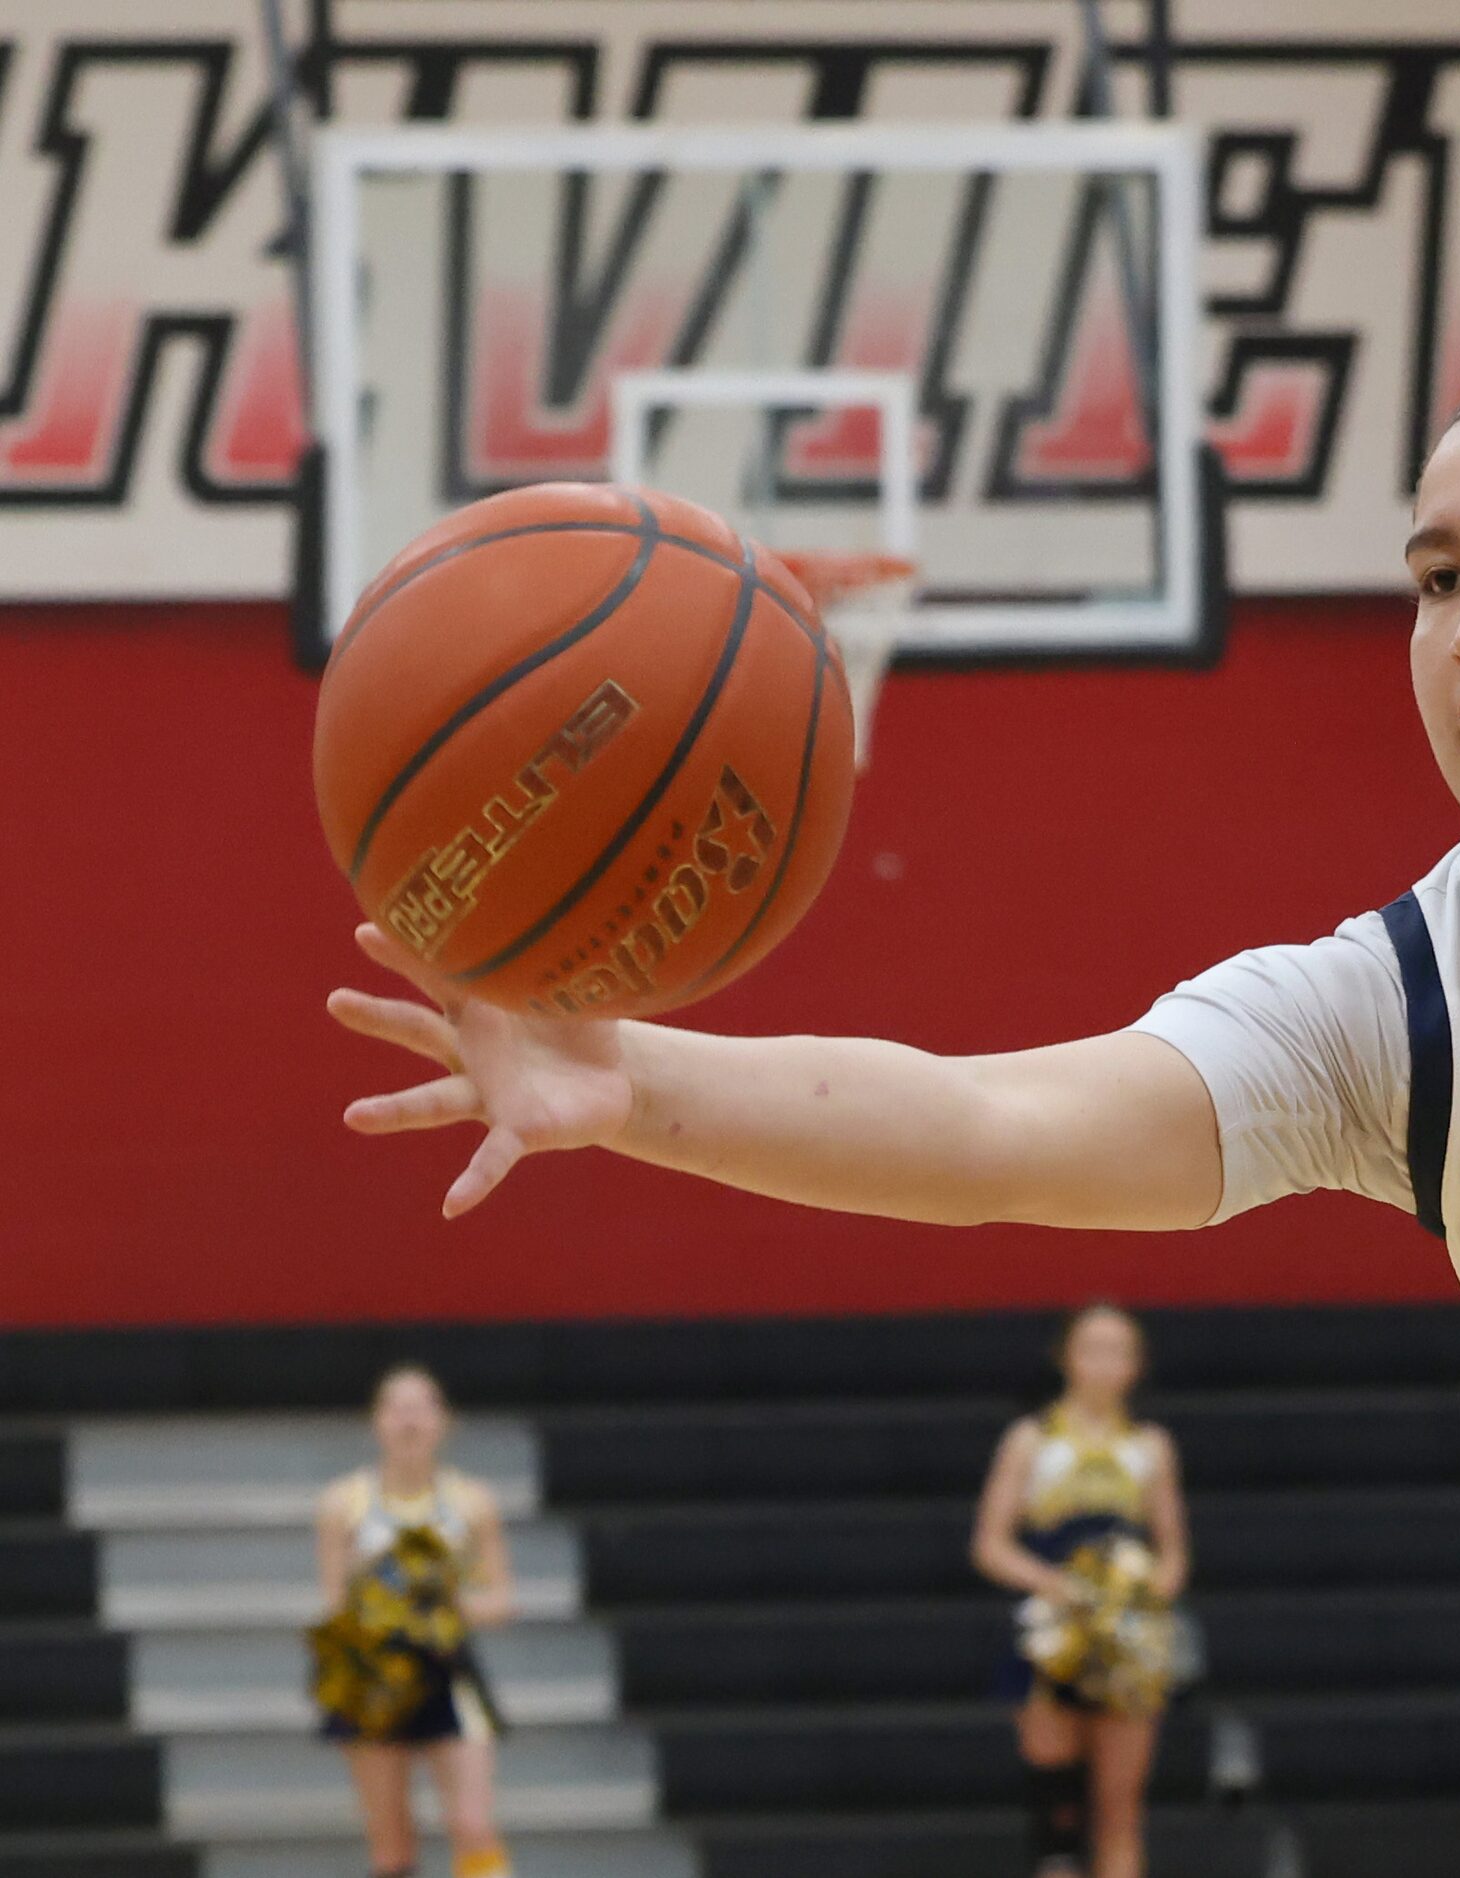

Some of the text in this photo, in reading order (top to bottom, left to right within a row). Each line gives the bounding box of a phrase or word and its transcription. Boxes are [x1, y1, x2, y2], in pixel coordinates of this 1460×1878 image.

[387, 678, 641, 955] ELITE PRO
[526, 763, 777, 1014] Baden
